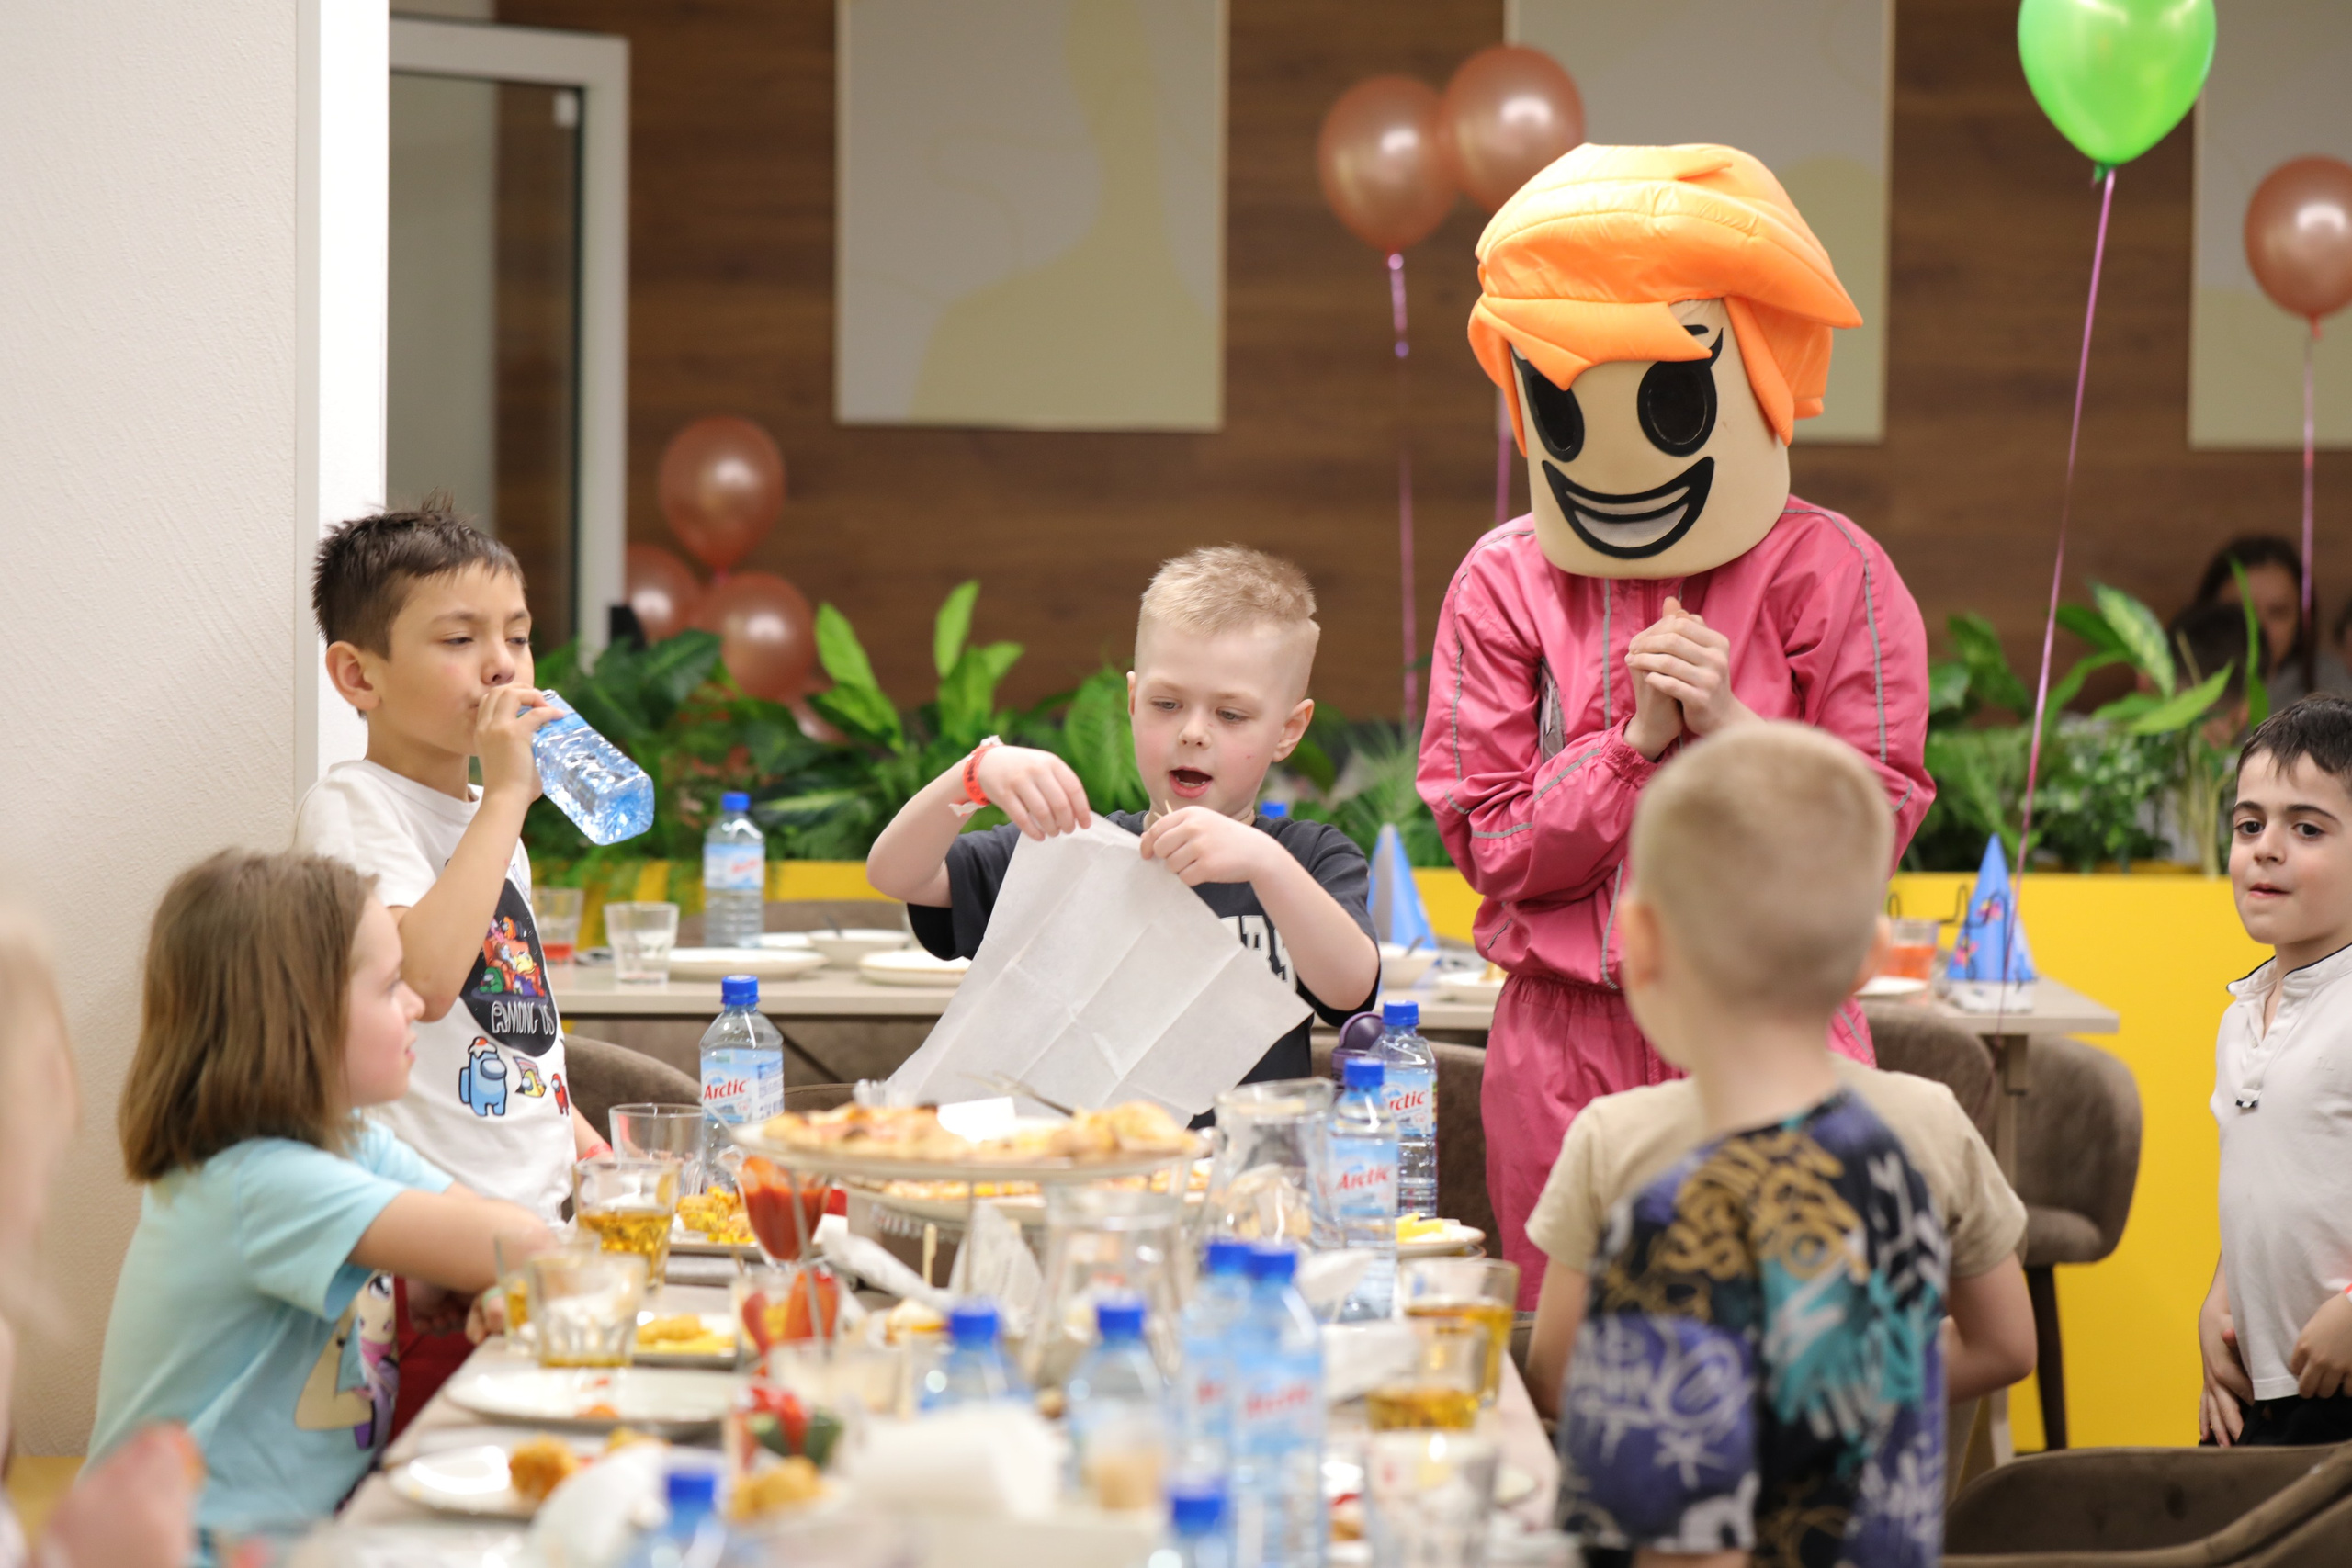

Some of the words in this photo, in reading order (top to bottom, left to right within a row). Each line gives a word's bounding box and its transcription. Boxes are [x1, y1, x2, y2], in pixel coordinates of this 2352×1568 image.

[491, 1000, 538, 1035] AMONG
[538, 1004, 555, 1035] US
[703, 1078, 747, 1100] Arctic
[1385, 1090, 1426, 1111] rctic
